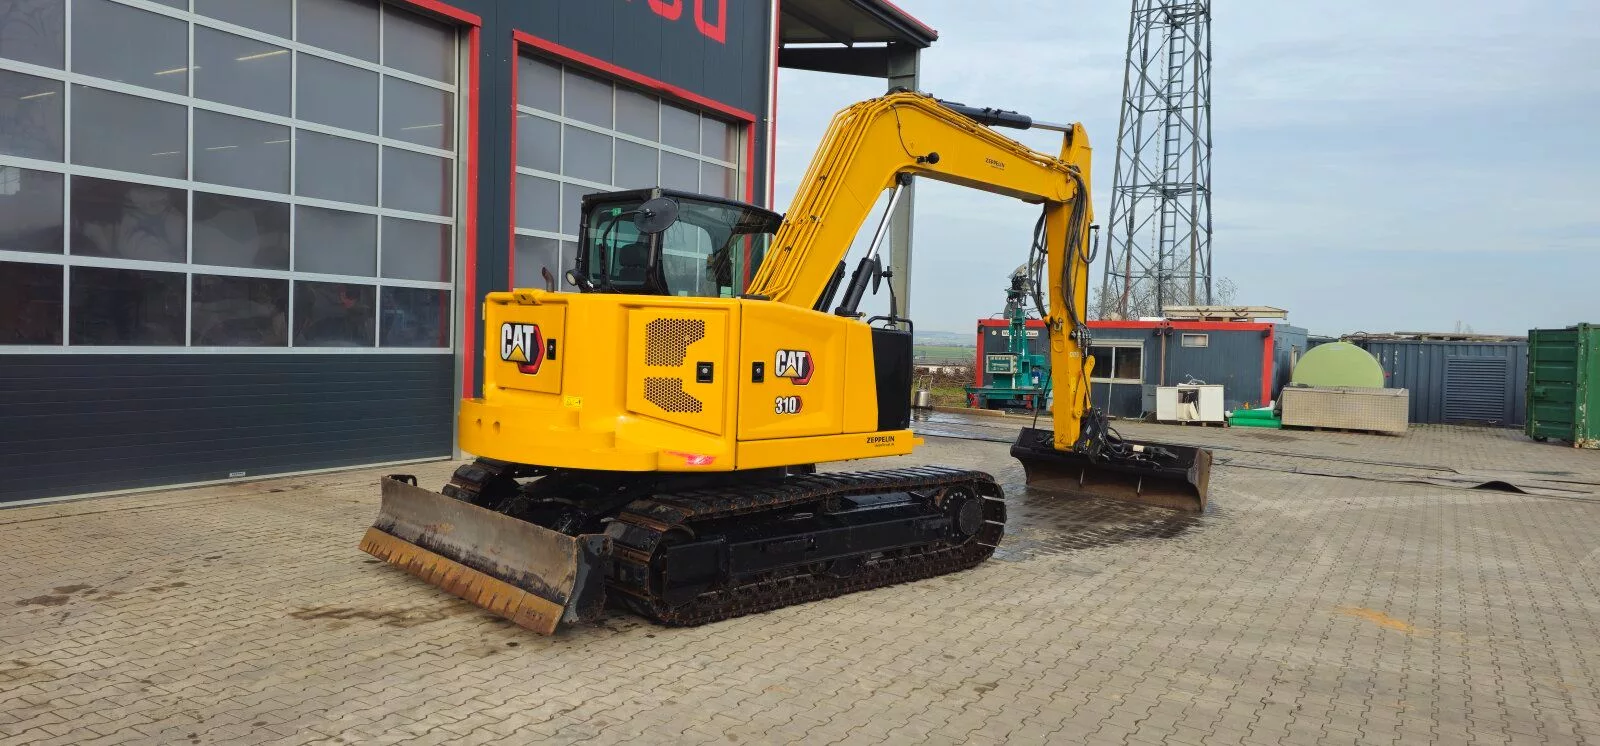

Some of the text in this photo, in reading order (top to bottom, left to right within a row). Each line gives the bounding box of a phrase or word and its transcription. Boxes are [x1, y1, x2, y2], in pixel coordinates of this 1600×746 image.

[501, 322, 535, 362] CAT
[775, 349, 806, 378] CAT
[775, 396, 797, 414] 310
[866, 435, 895, 444] ZEPPELIN
